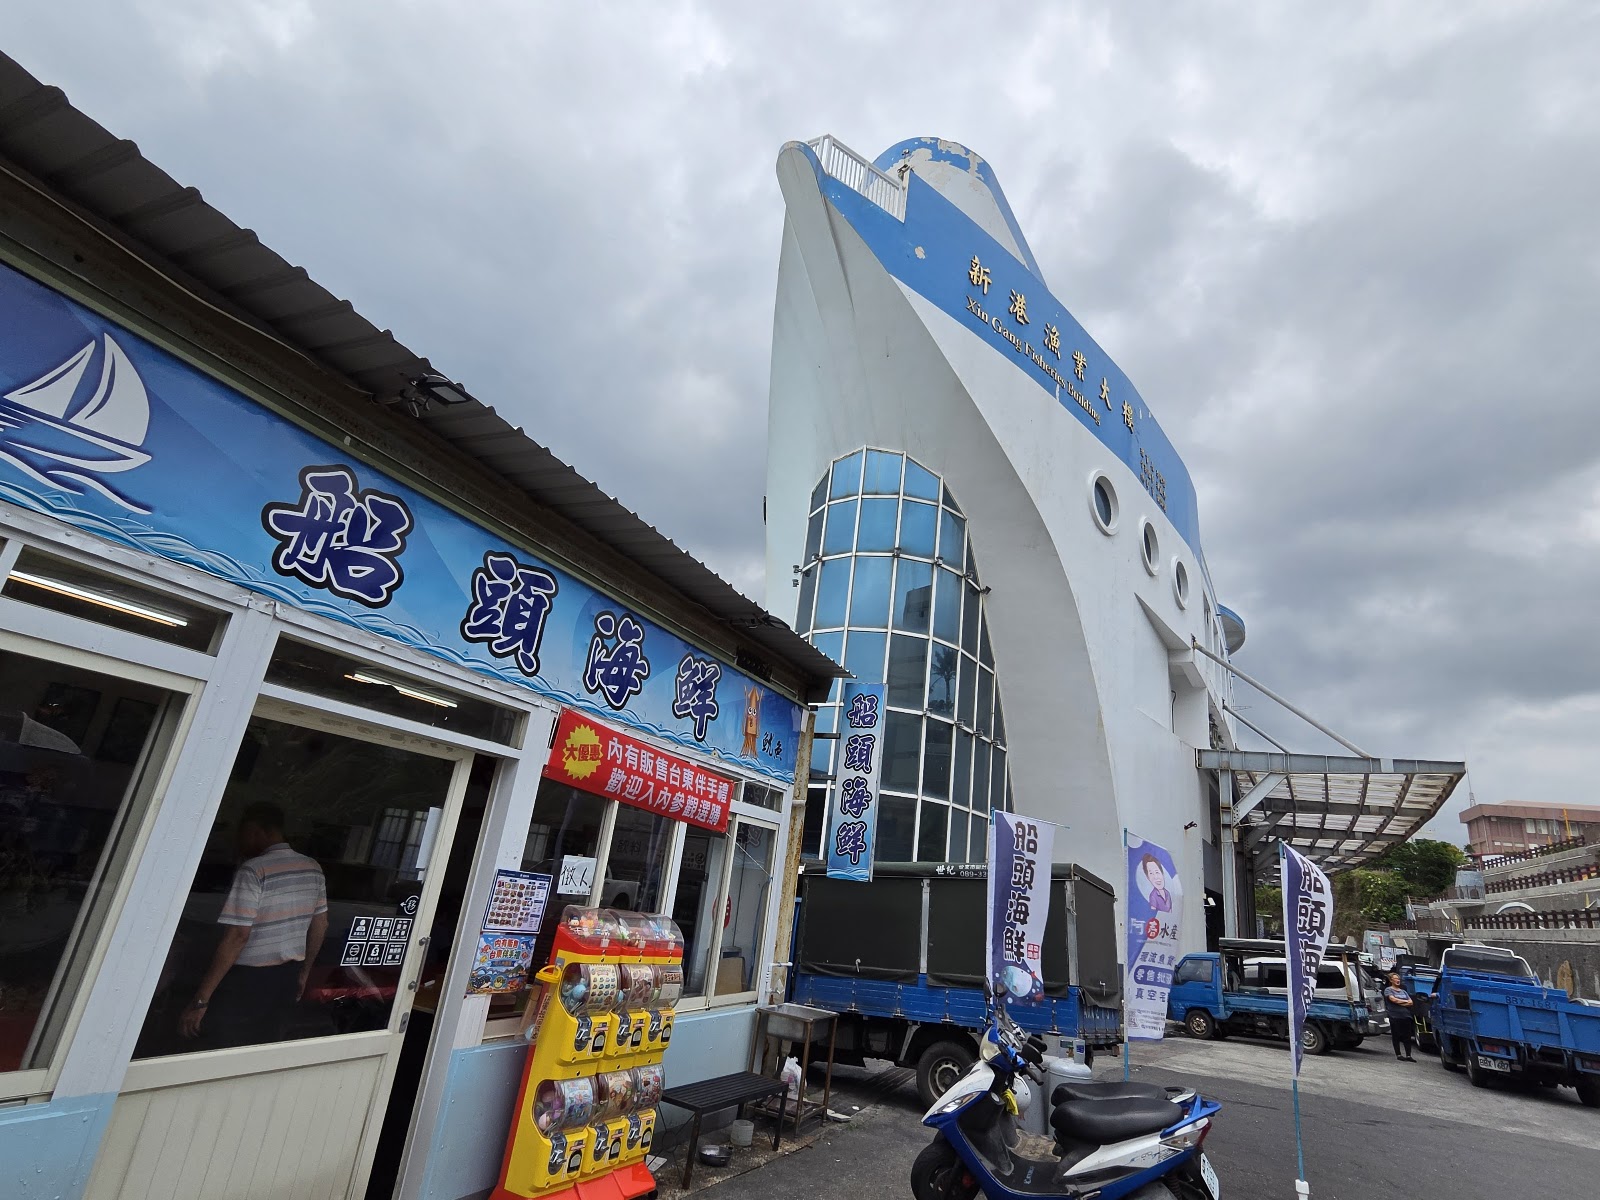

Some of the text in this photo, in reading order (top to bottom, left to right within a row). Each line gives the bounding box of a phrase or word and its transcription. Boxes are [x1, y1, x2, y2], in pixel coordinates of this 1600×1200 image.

[966, 295, 1101, 425] Xin Gang Fisheries Building
[968, 255, 1135, 433] 新港漁業大樓
[261, 464, 723, 742] 船頭海鮮
[565, 743, 601, 762] 大優惠
[836, 693, 878, 864] 船頭海鮮
[935, 864, 956, 876] 世紀
[1002, 820, 1039, 964] 船頭海鮮
